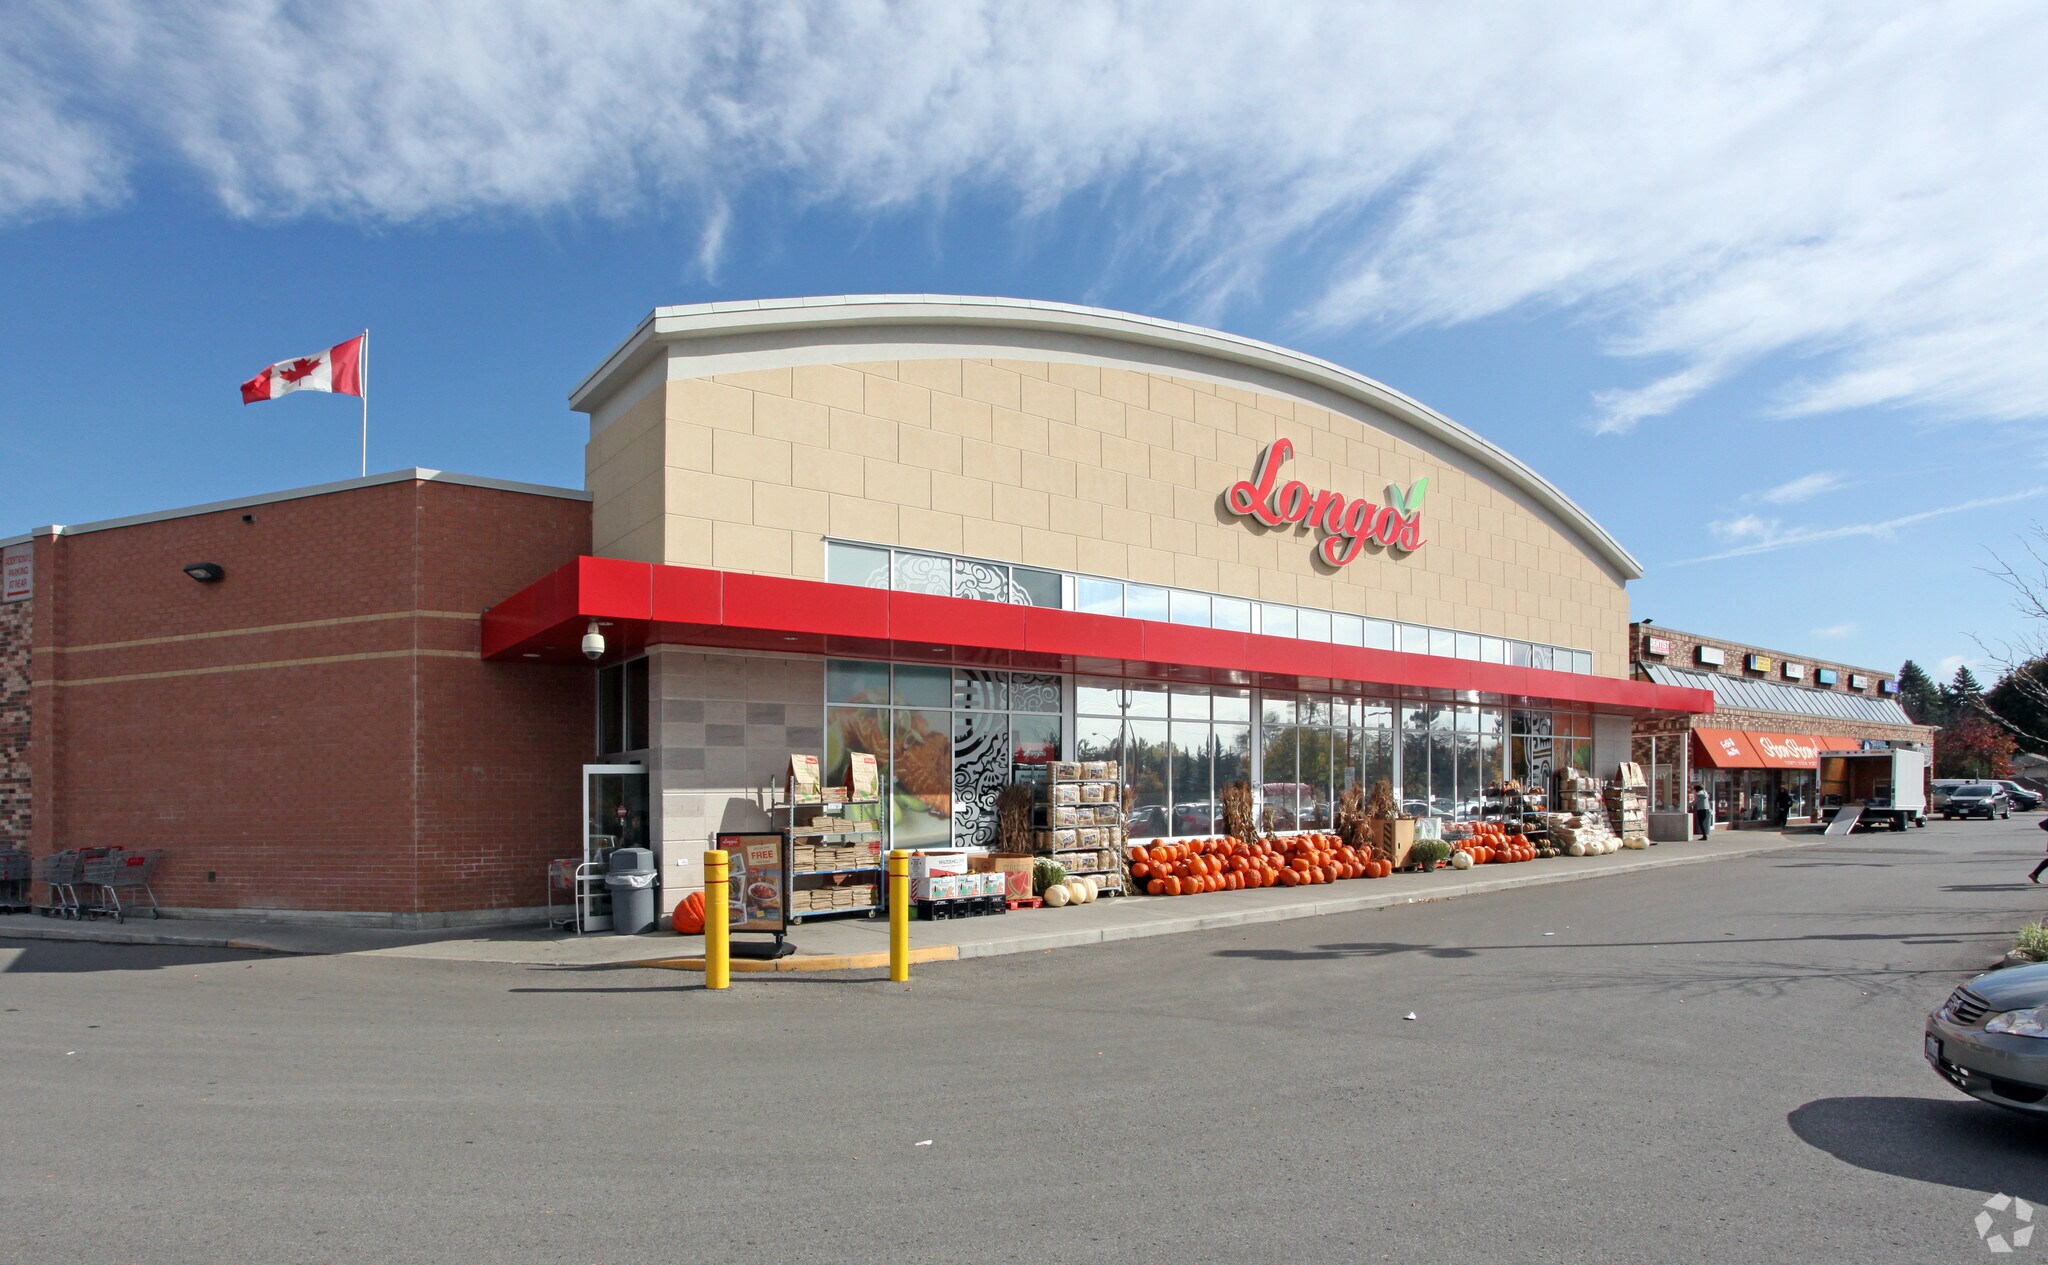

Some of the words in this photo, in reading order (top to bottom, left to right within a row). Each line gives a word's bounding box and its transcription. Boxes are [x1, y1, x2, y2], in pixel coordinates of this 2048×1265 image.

[8, 566, 30, 577] PARKING
[15, 578, 28, 588] REAR
[751, 850, 774, 860] FREE
